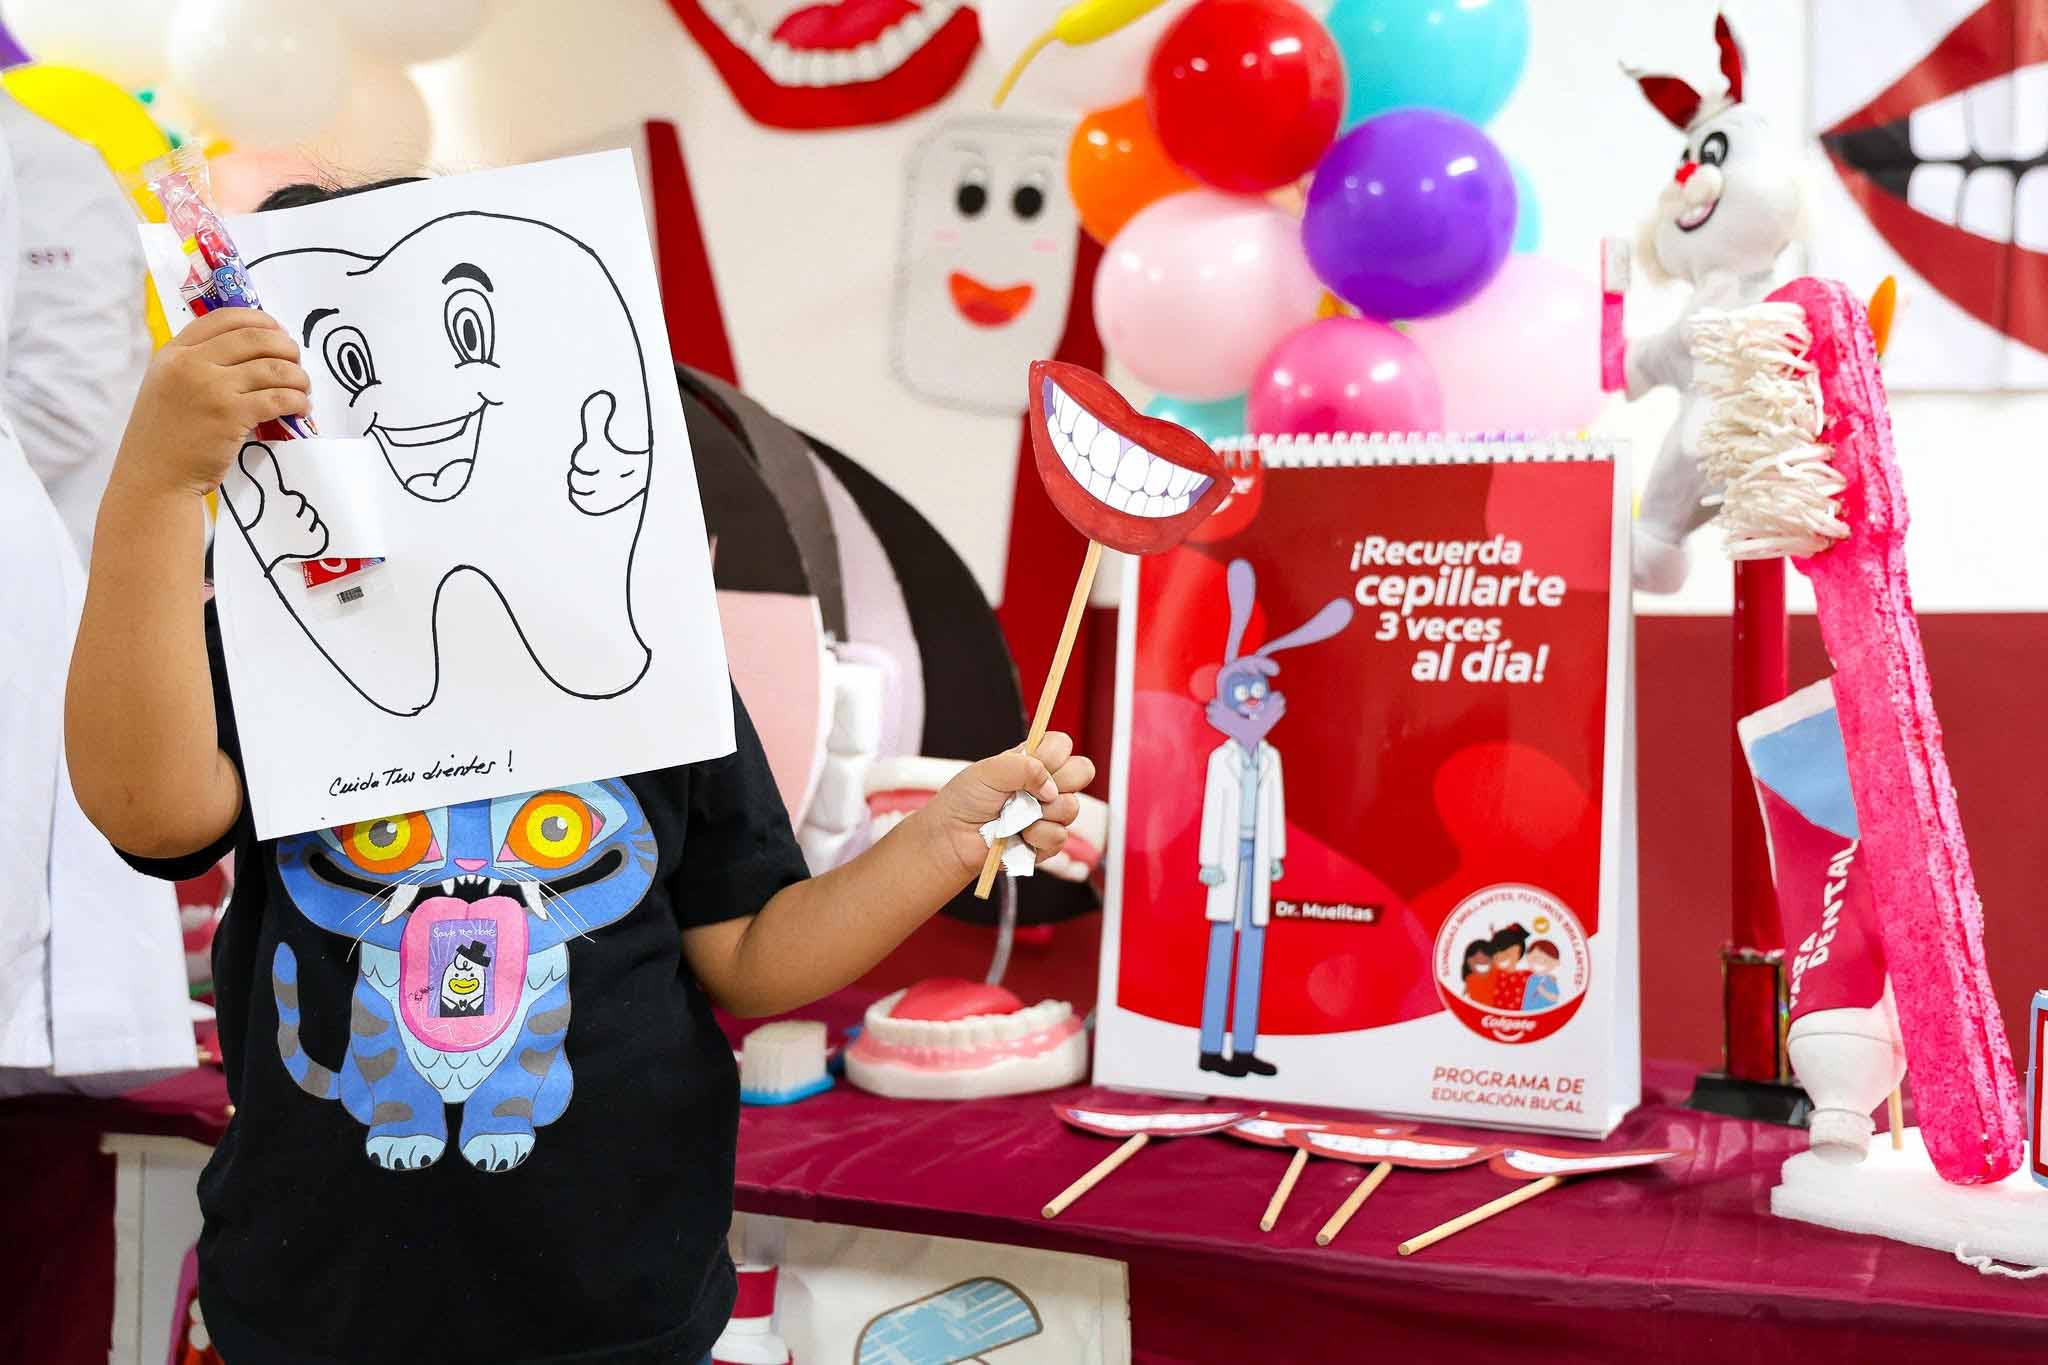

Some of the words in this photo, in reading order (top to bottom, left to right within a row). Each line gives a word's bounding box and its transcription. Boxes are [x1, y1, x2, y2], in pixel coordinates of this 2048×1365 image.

[1350, 534, 1523, 572] ¡Recuerda
[1354, 565, 1568, 616] cepillarte
[1375, 611, 1399, 641] 3
[1406, 616, 1502, 641] veces
[1411, 642, 1456, 682] al
[1461, 639, 1549, 684] día!
[328, 772, 379, 797] Cuida
[1275, 900, 1301, 917] Dr.
[1302, 901, 1374, 922] Muelitas
[1807, 840, 1859, 968] DENTAL
[1481, 1014, 1537, 1031] Colgate
[1432, 1066, 1550, 1091] PROGRAMA
[1556, 1076, 1585, 1095] DE
[1431, 1087, 1525, 1108] EDUCACIÓN
[1530, 1095, 1584, 1114] BUCAL
